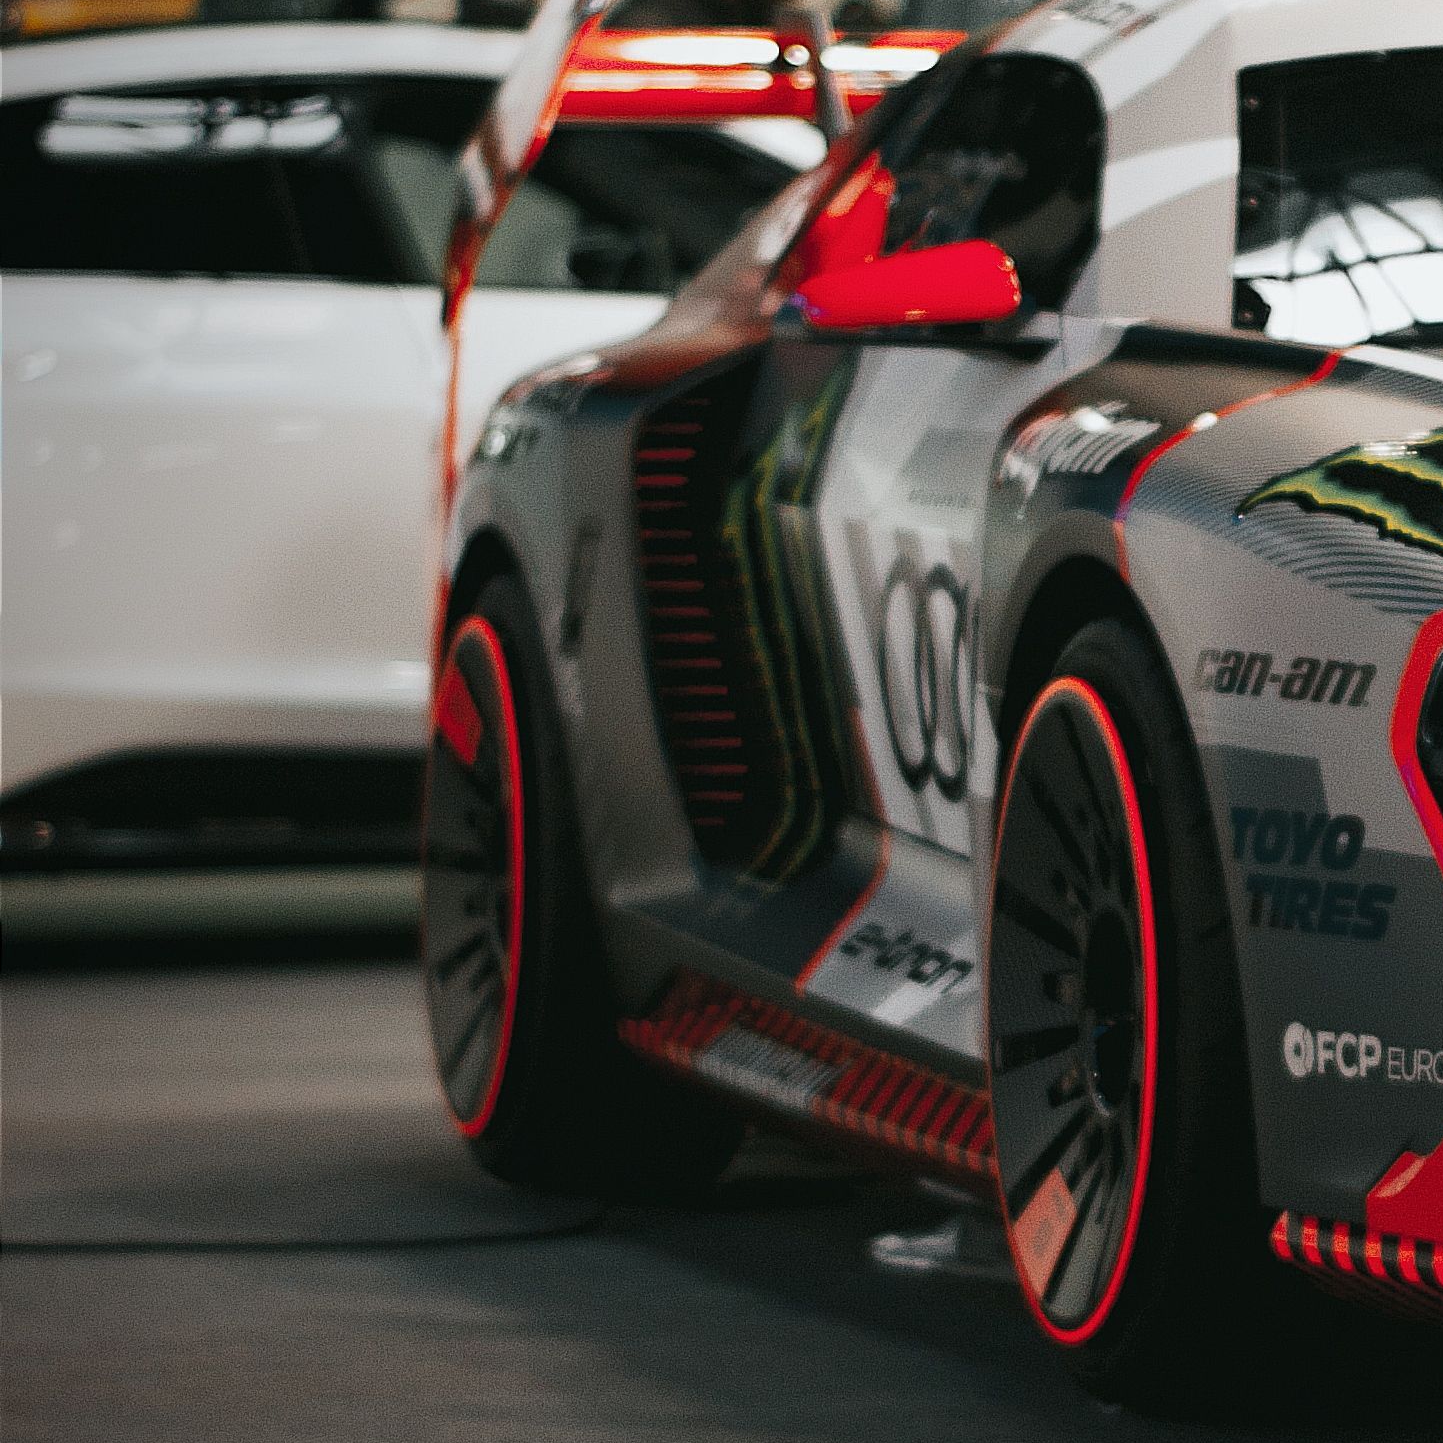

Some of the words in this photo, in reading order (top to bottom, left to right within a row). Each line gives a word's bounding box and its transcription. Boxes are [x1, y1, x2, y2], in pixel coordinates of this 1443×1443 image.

[1199, 649, 1377, 706] can-am
[1230, 807, 1366, 870] TOYO
[1247, 874, 1396, 941] TIRES
[1316, 1030, 1382, 1078] FCP
